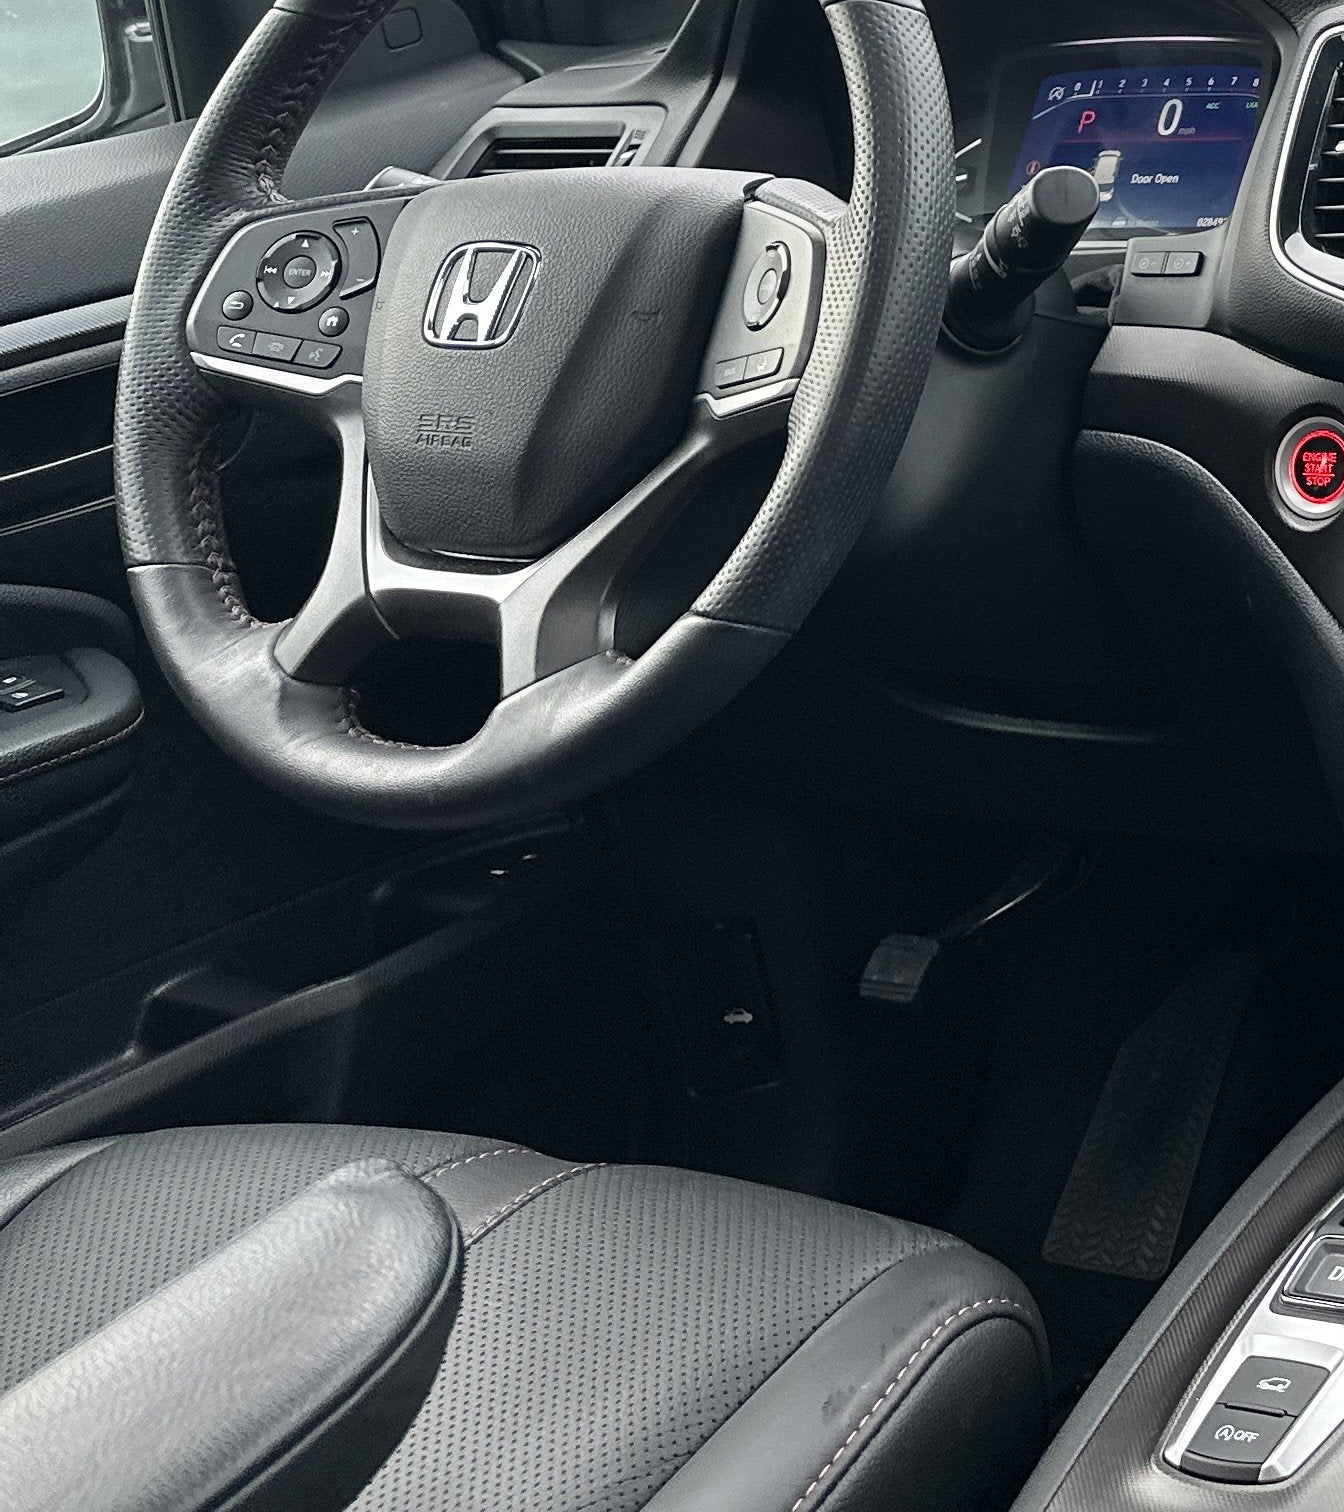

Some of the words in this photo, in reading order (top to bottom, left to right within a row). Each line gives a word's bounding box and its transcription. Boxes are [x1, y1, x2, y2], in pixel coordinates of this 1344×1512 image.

[1077, 109, 1097, 134] P
[1157, 97, 1184, 136] 0
[1177, 126, 1197, 136] mph
[1130, 172, 1153, 185] Door
[1154, 173, 1179, 186] Open
[288, 268, 312, 276] ENTER
[417, 413, 475, 431] SRS
[1302, 451, 1338, 463] ENGINE
[1303, 463, 1334, 474] START
[1305, 476, 1331, 487] STOP
[1233, 1428, 1260, 1443] OFF
